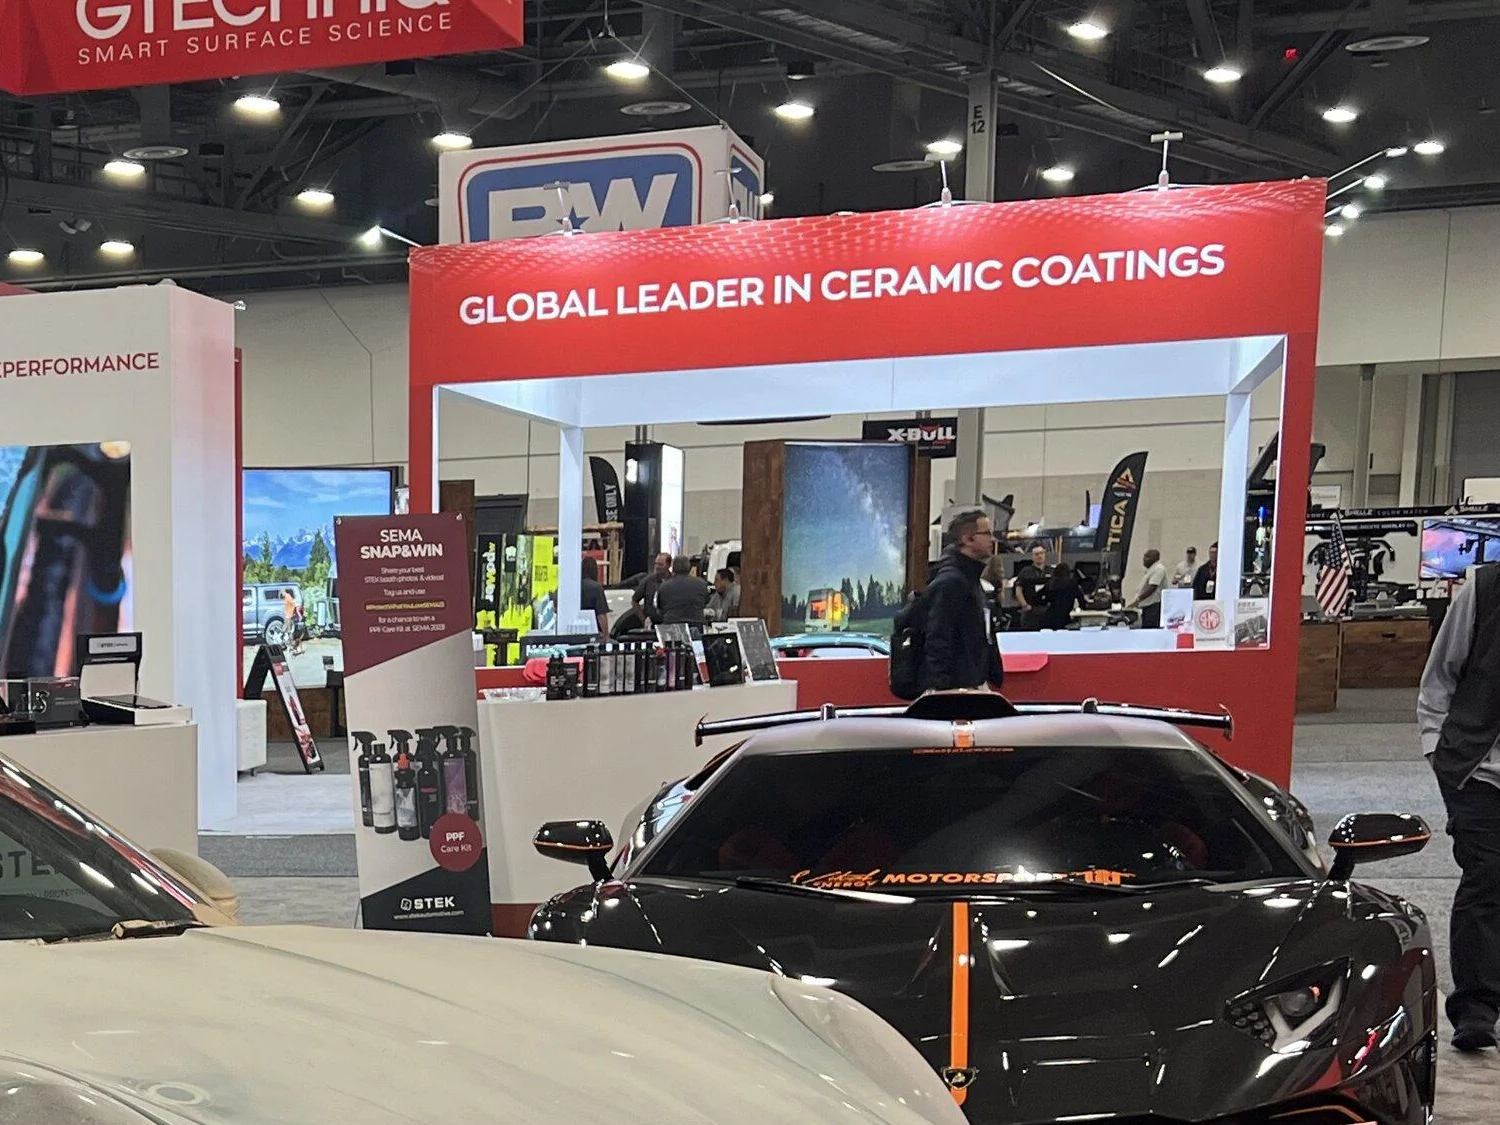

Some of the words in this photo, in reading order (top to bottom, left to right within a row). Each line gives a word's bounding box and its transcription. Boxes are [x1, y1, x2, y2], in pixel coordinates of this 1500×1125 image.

[78, 39, 168, 65] SMART
[186, 27, 311, 54] SURFACE
[328, 12, 452, 41] SCIENCE
[974, 105, 983, 119] E
[970, 120, 985, 134] 12
[459, 288, 608, 325] GLOBAL
[617, 277, 764, 315] LEADER
[774, 273, 811, 304] IN
[820, 259, 1002, 301] CERAMIC
[1012, 244, 1226, 288] COATINGS
[887, 424, 956, 441] X-BULL
[380, 528, 423, 542] SEMA
[360, 543, 443, 559] SNAP&WIN
[445, 831, 464, 842] PPF
[440, 844, 459, 853] Care
[461, 842, 472, 852] Kit
[414, 896, 456, 910] STEK
